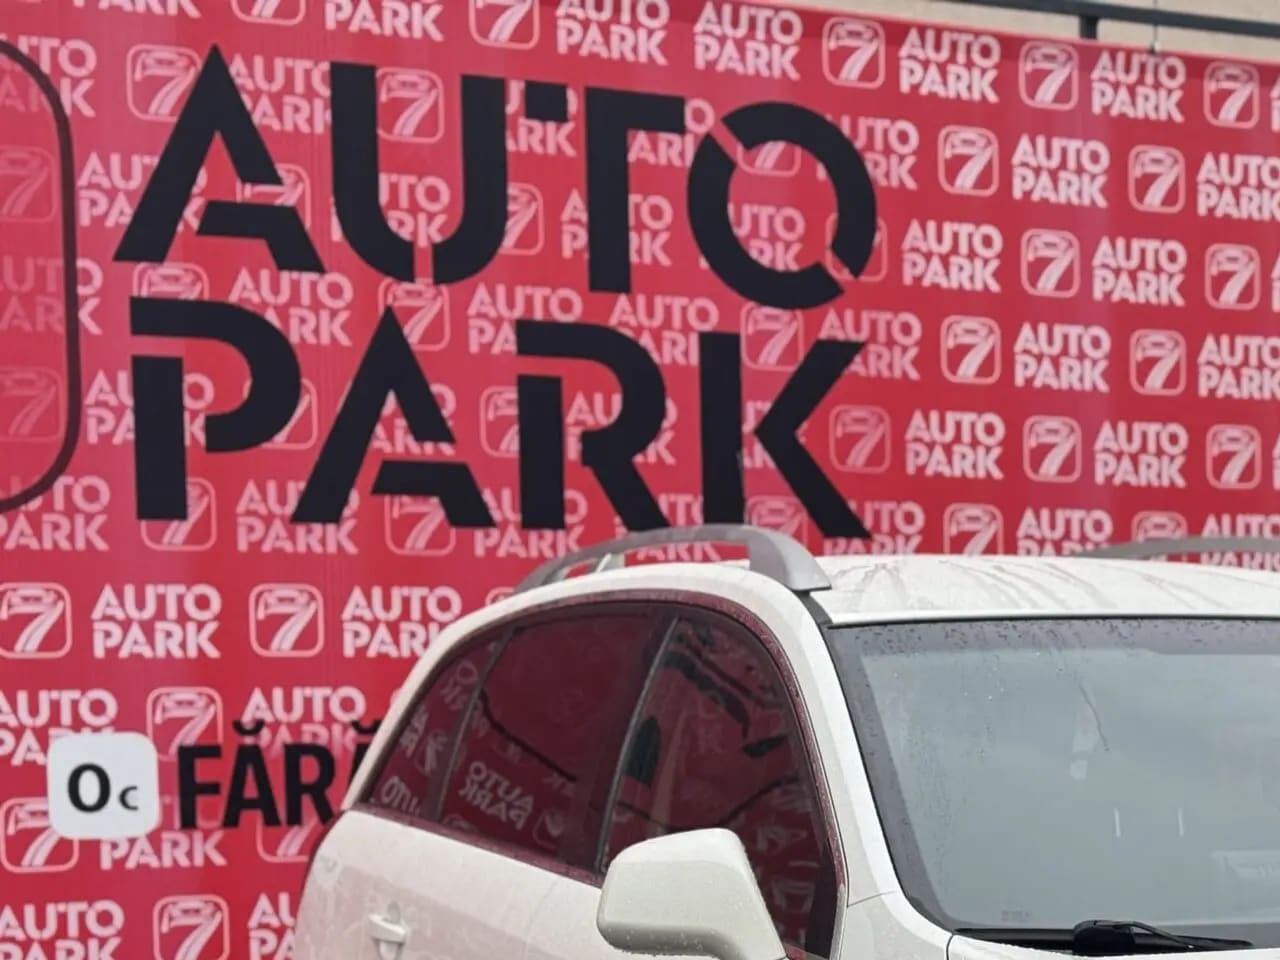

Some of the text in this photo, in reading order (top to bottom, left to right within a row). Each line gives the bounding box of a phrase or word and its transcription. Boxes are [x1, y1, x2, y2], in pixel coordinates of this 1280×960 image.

[556, 18, 668, 66] PARK
[694, 1, 803, 45] AUTO
[694, 33, 800, 80] PARK
[898, 27, 1000, 68] AUTO
[899, 60, 999, 103] PARK
[1090, 50, 1186, 89] AUTO
[1091, 85, 1184, 122] PARK
[1011, 134, 1109, 174] AUTO
[112, 43, 877, 310] AUTO
[1012, 168, 1108, 208] PARK
[901, 219, 1003, 259] AUTO
[1091, 237, 1187, 275] AUTO
[228, 267, 353, 309] AUTO
[902, 252, 1002, 293] PARK
[1093, 270, 1185, 306] PARK
[467, 282, 583, 322] AUTO
[609, 293, 719, 332] AUTO
[820, 308, 922, 345] AUTO
[1014, 321, 1112, 359] AUTO
[846, 342, 920, 380] ARK
[1014, 355, 1110, 393] PARK
[129, 294, 872, 539] PARK
[905, 409, 1006, 448] AUTO
[1094, 419, 1190, 456] AUTO
[906, 443, 1004, 480] PARK
[1094, 453, 1187, 488] PARK
[236, 516, 359, 554] PARK
[1017, 507, 1114, 541] AUTO
[91, 584, 222, 621] AUTO
[341, 585, 463, 622] AUTO
[92, 620, 222, 659] PARK
[241, 686, 366, 726] AUTO
[99, 831, 227, 870] PARK
